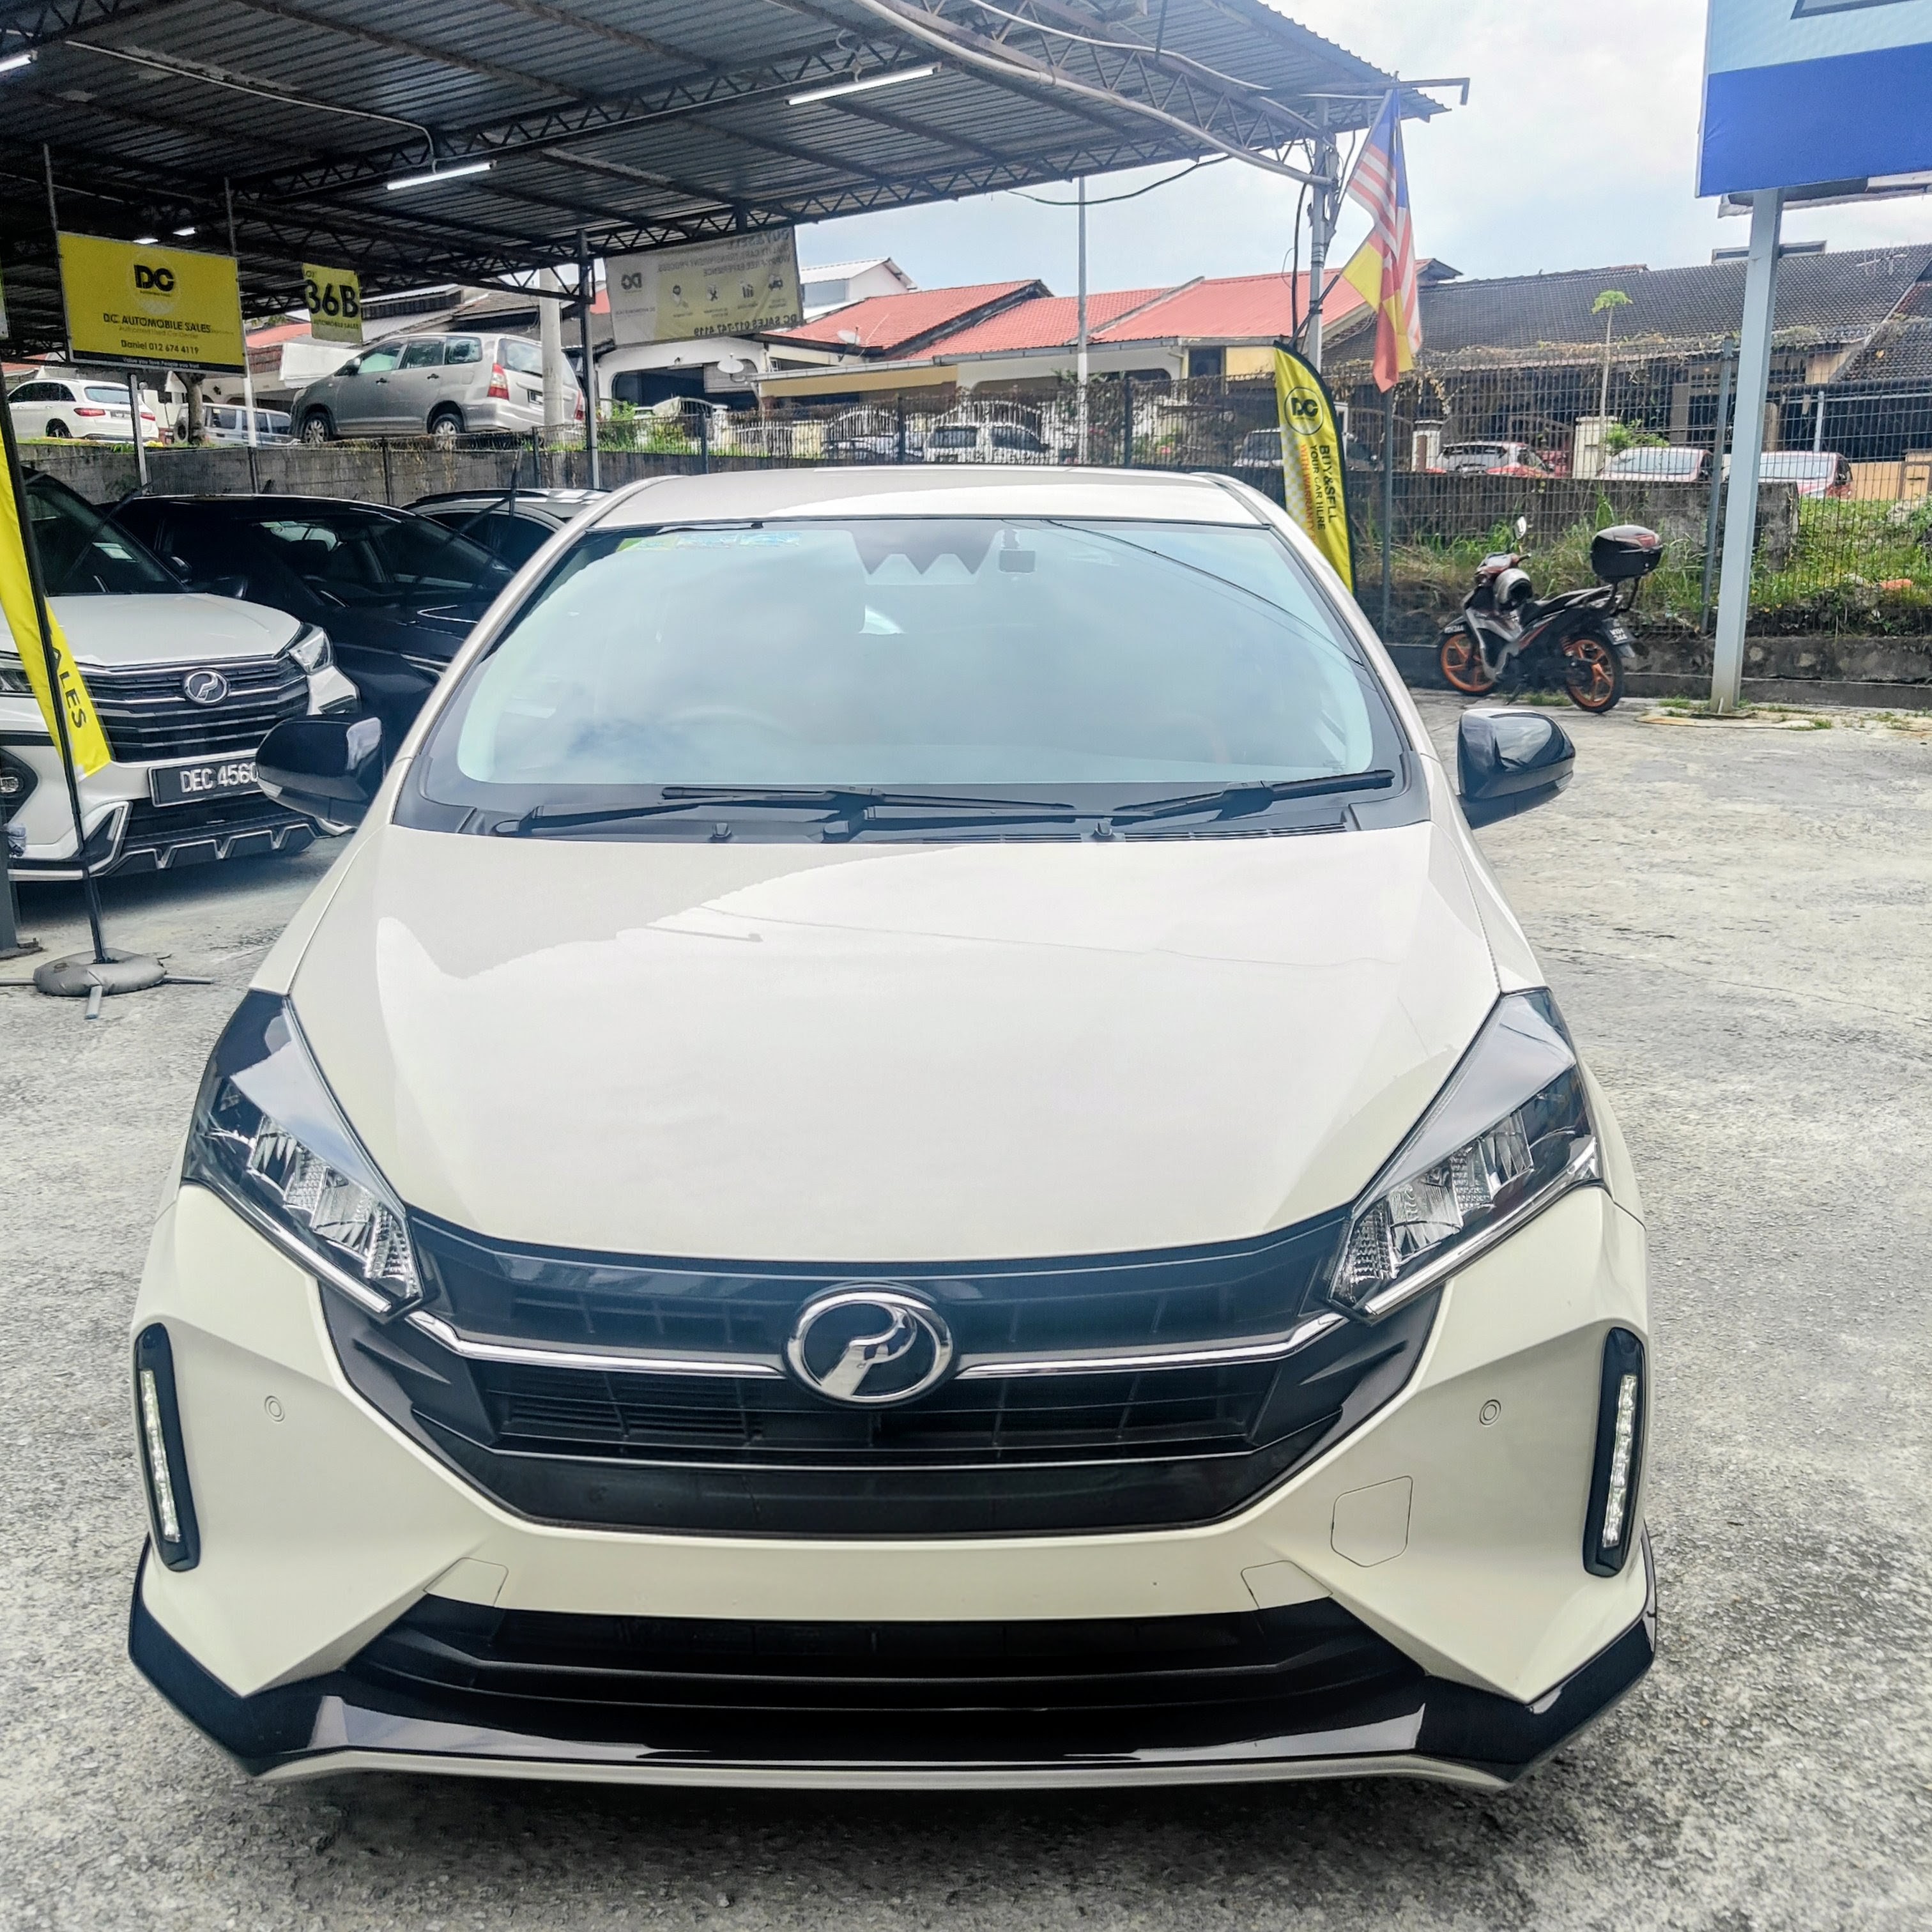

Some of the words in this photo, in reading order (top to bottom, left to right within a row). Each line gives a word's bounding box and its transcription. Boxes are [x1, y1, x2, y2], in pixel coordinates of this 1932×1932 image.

[134, 264, 174, 291] DC
[305, 279, 358, 318] 36B
[103, 313, 119, 324] DC
[121, 315, 183, 330] AUTOMOBILE
[185, 323, 211, 334] SALES
[121, 340, 147, 349] Daniel
[149, 342, 163, 351] 012
[165, 344, 179, 353] 674
[181, 346, 199, 355] 4119
[1291, 397, 1319, 417] DC
[1301, 445, 1309, 470] WITH
[1310, 445, 1319, 474] YOUR
[1314, 477, 1322, 499] CAR
[1304, 473, 1315, 532] WARRANTY
[52, 647, 87, 728] ALES
[180, 768, 213, 793] DEC
